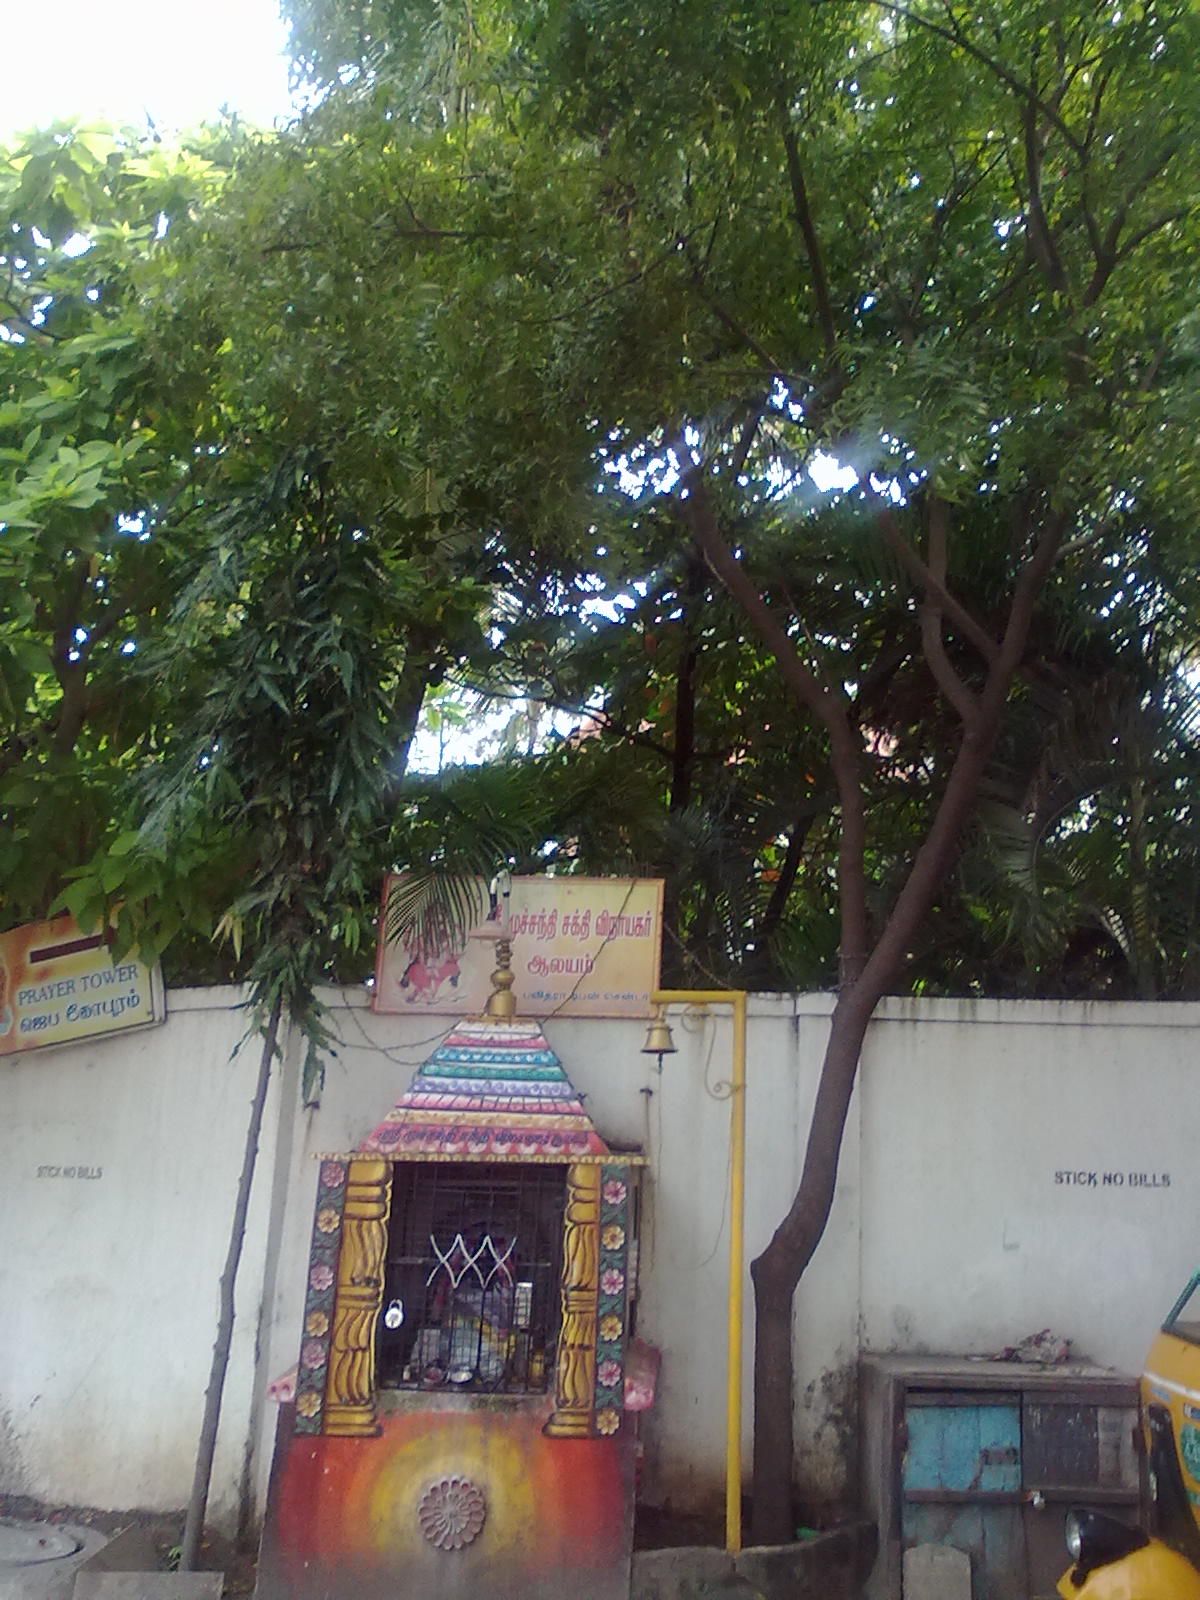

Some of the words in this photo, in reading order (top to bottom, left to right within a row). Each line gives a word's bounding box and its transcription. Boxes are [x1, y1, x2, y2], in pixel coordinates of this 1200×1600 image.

[562, 909, 591, 941] சக்தி
[527, 954, 593, 977] ஆலயம்
[18, 978, 76, 1005] PRAYER
[80, 964, 138, 992] TOWER
[1055, 1170, 1097, 1188] STICK
[1102, 1172, 1124, 1187] NO
[1128, 1173, 1170, 1188] BILLS
